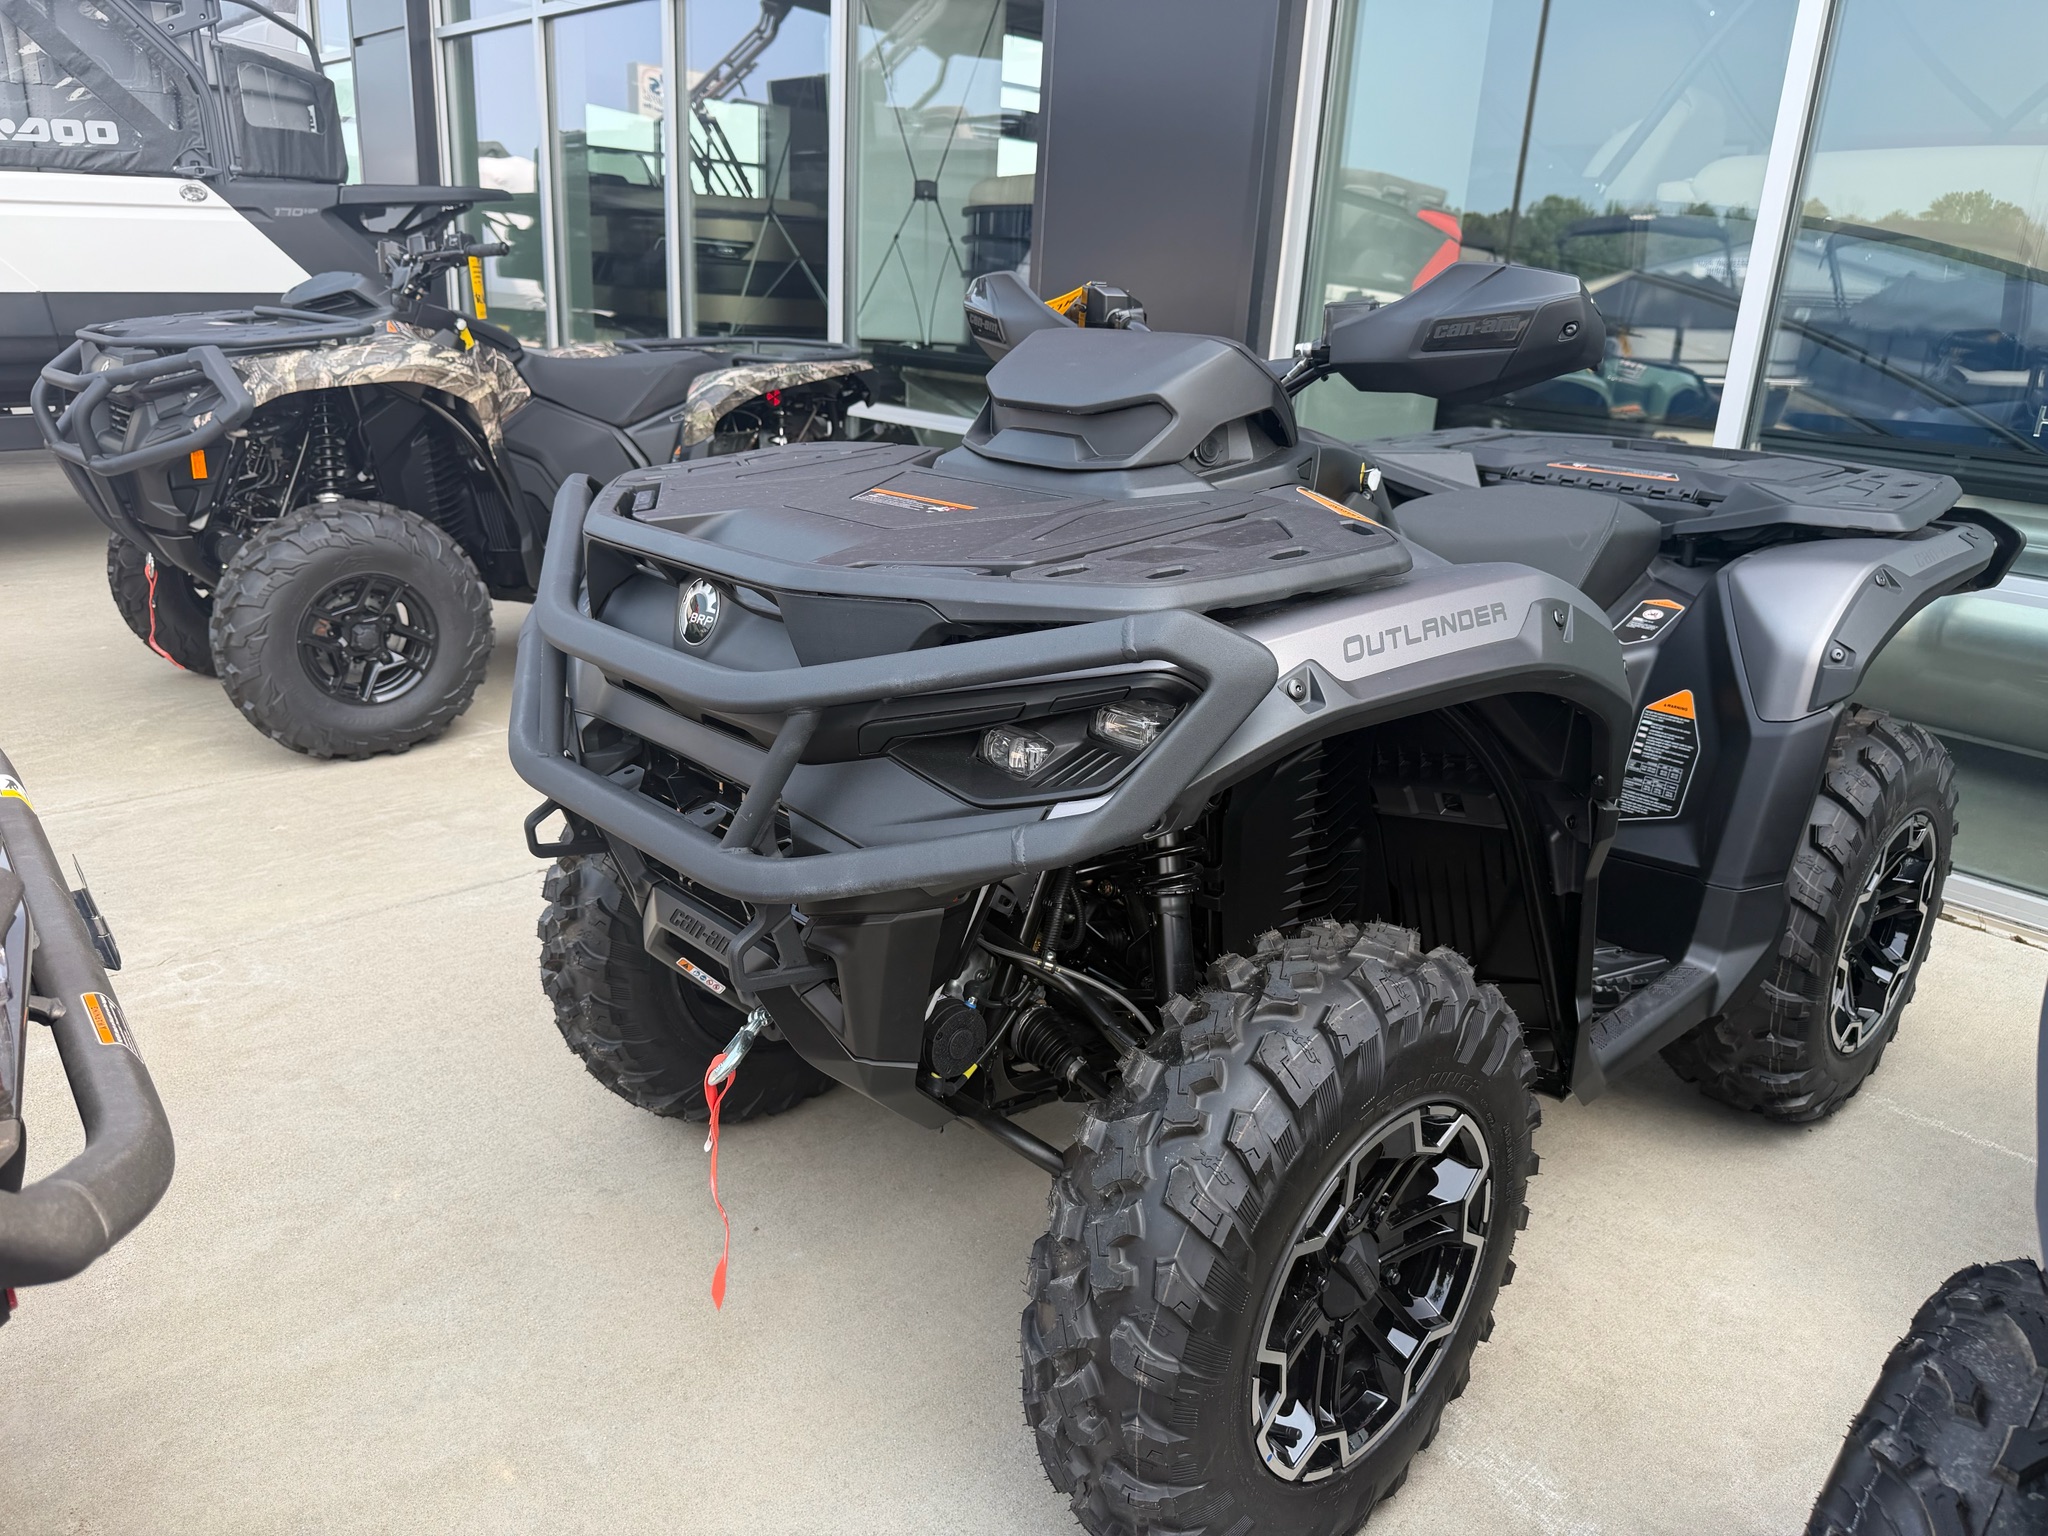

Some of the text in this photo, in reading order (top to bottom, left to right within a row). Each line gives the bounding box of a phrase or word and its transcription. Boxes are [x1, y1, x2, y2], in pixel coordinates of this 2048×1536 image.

[1433, 316, 1519, 339] can-am
[690, 612, 714, 626] BRP
[1343, 602, 1508, 664] OUTLANDER
